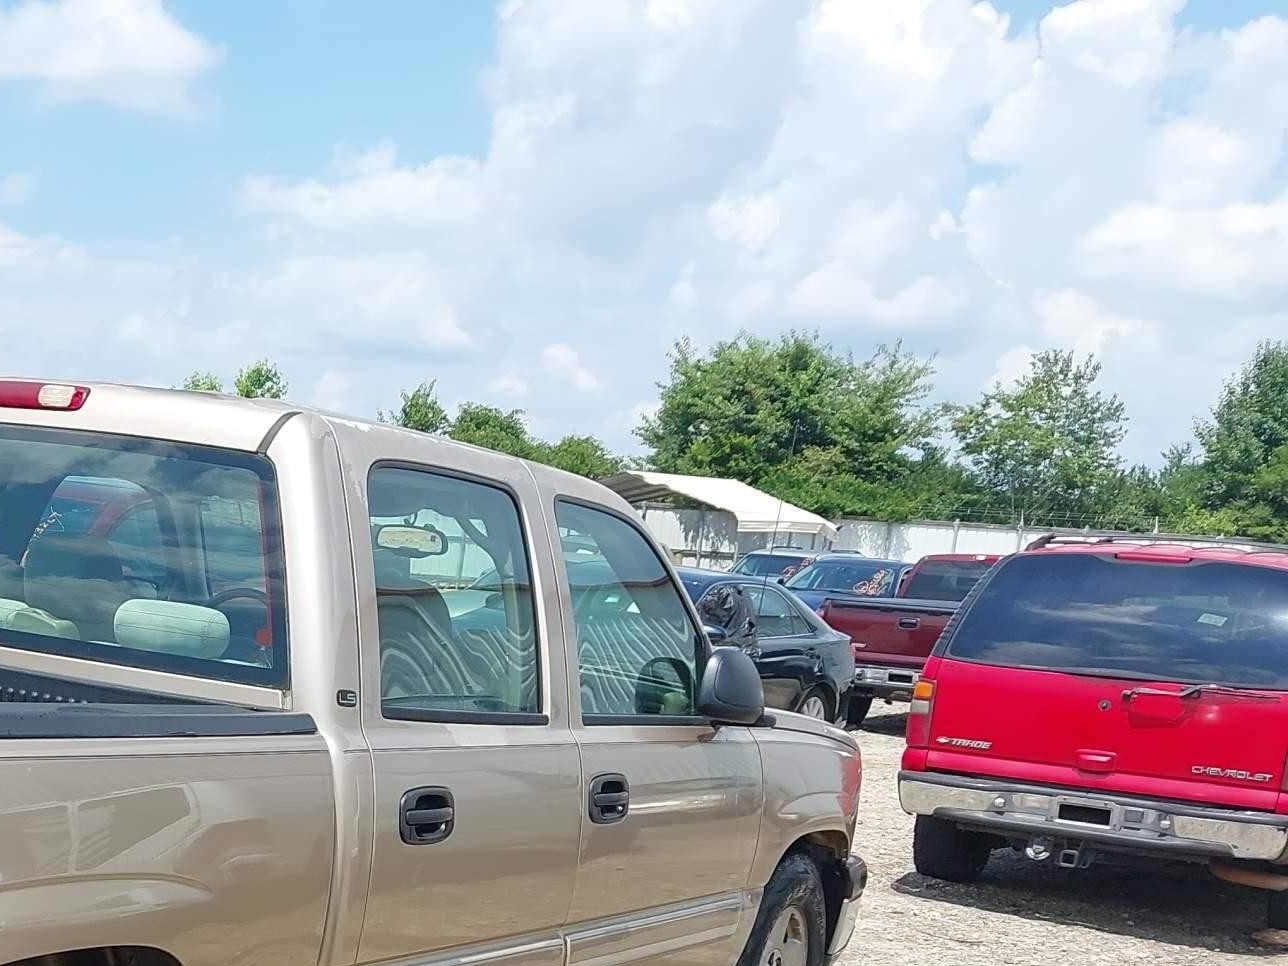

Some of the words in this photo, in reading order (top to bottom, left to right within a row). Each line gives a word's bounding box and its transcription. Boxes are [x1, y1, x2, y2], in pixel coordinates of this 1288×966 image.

[339, 691, 357, 704] LS
[951, 738, 993, 750] TAHOE
[1191, 765, 1274, 783] CHEVROLET
